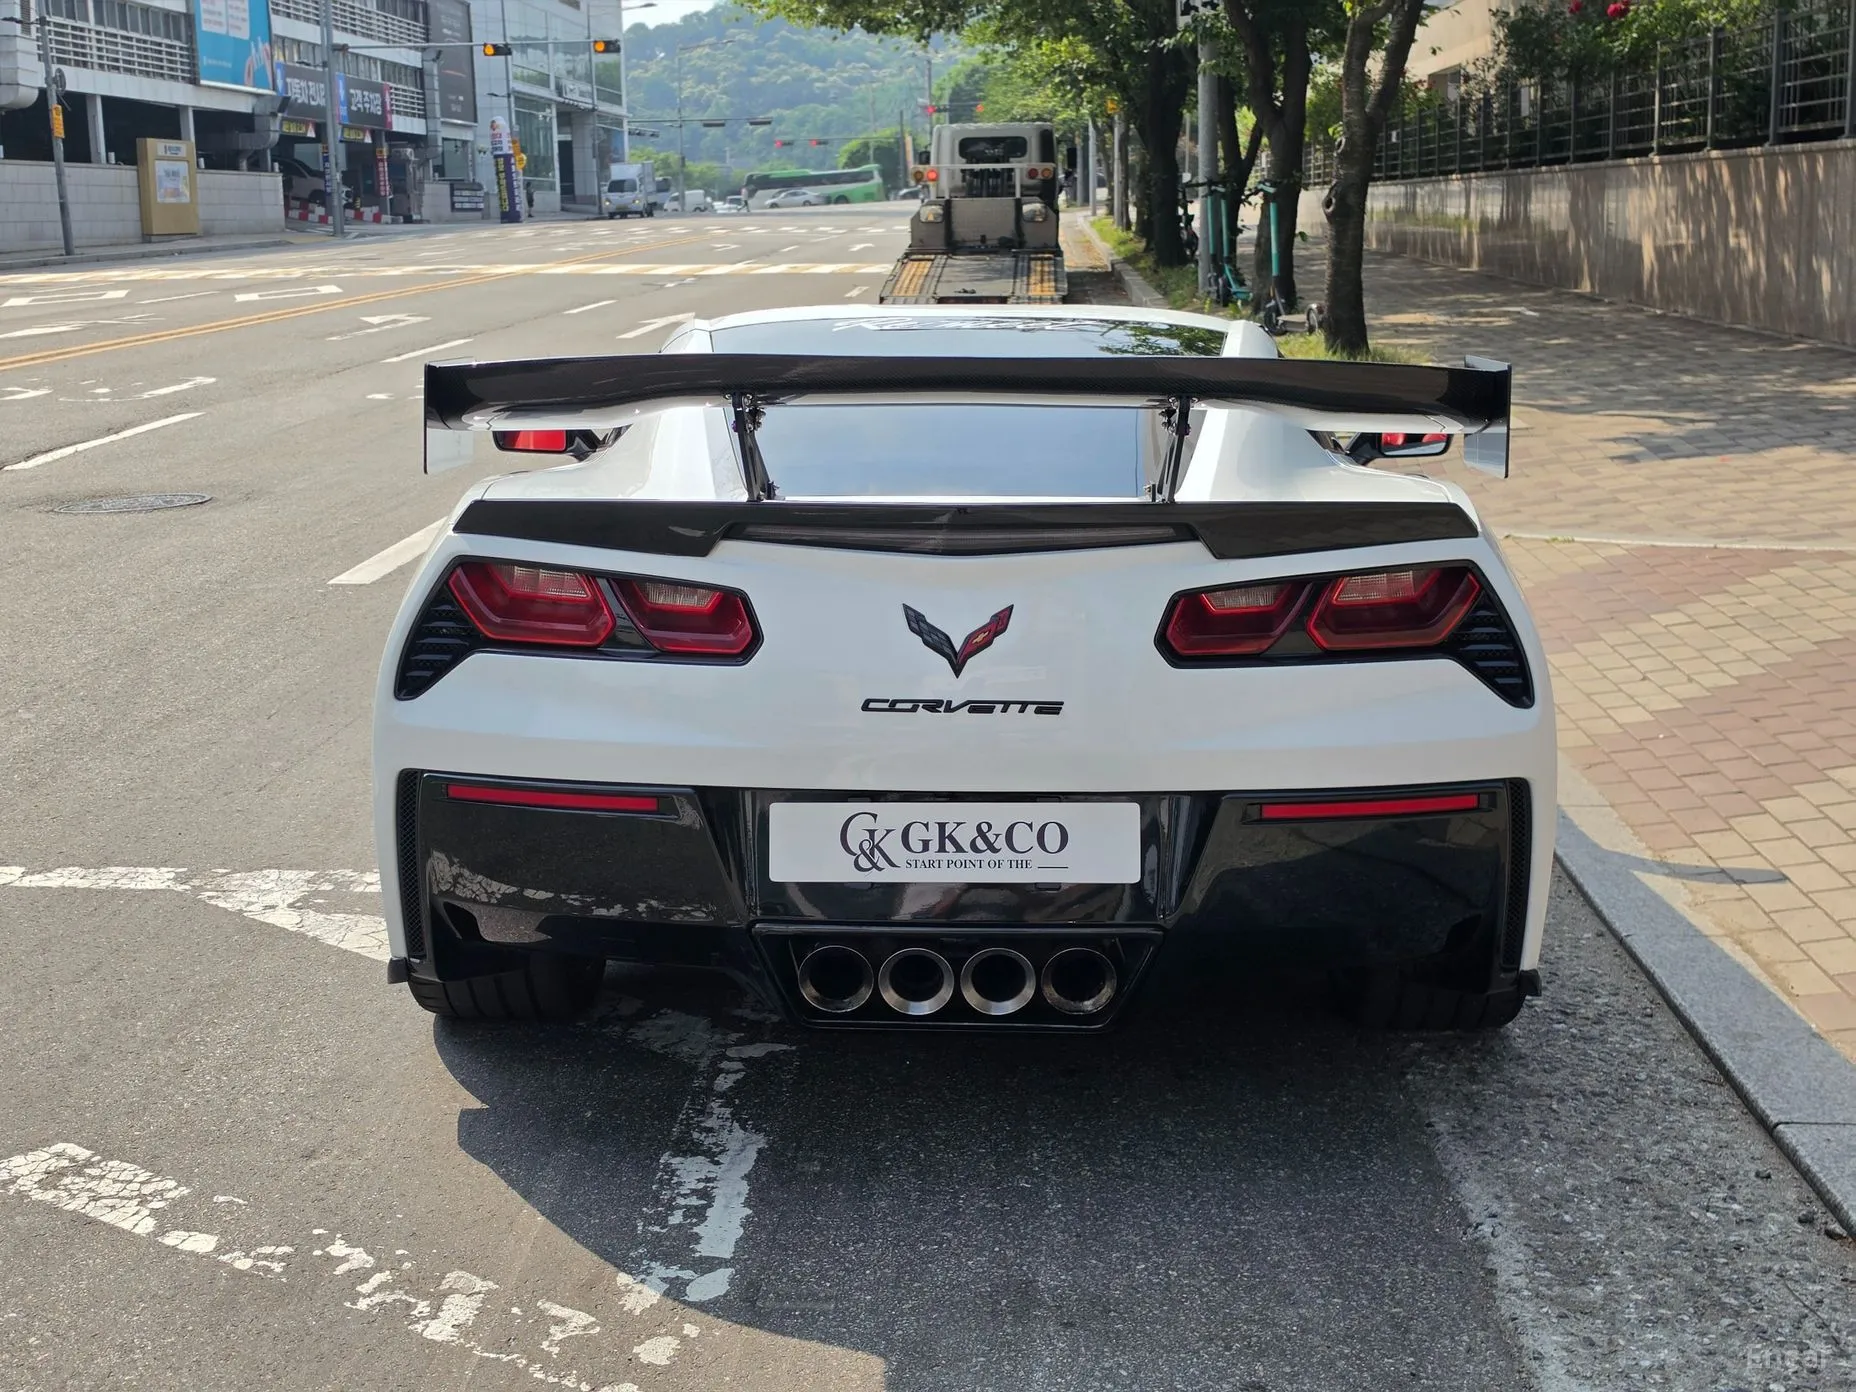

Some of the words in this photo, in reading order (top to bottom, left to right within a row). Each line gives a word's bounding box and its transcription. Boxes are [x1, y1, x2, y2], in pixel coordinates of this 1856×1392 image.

[861, 698, 1064, 715] CORVETTE
[901, 821, 1069, 854] GK&CO
[905, 859, 944, 869] START
[946, 859, 985, 869] POINT
[987, 859, 1005, 869] OF
[1006, 859, 1033, 869] THE
